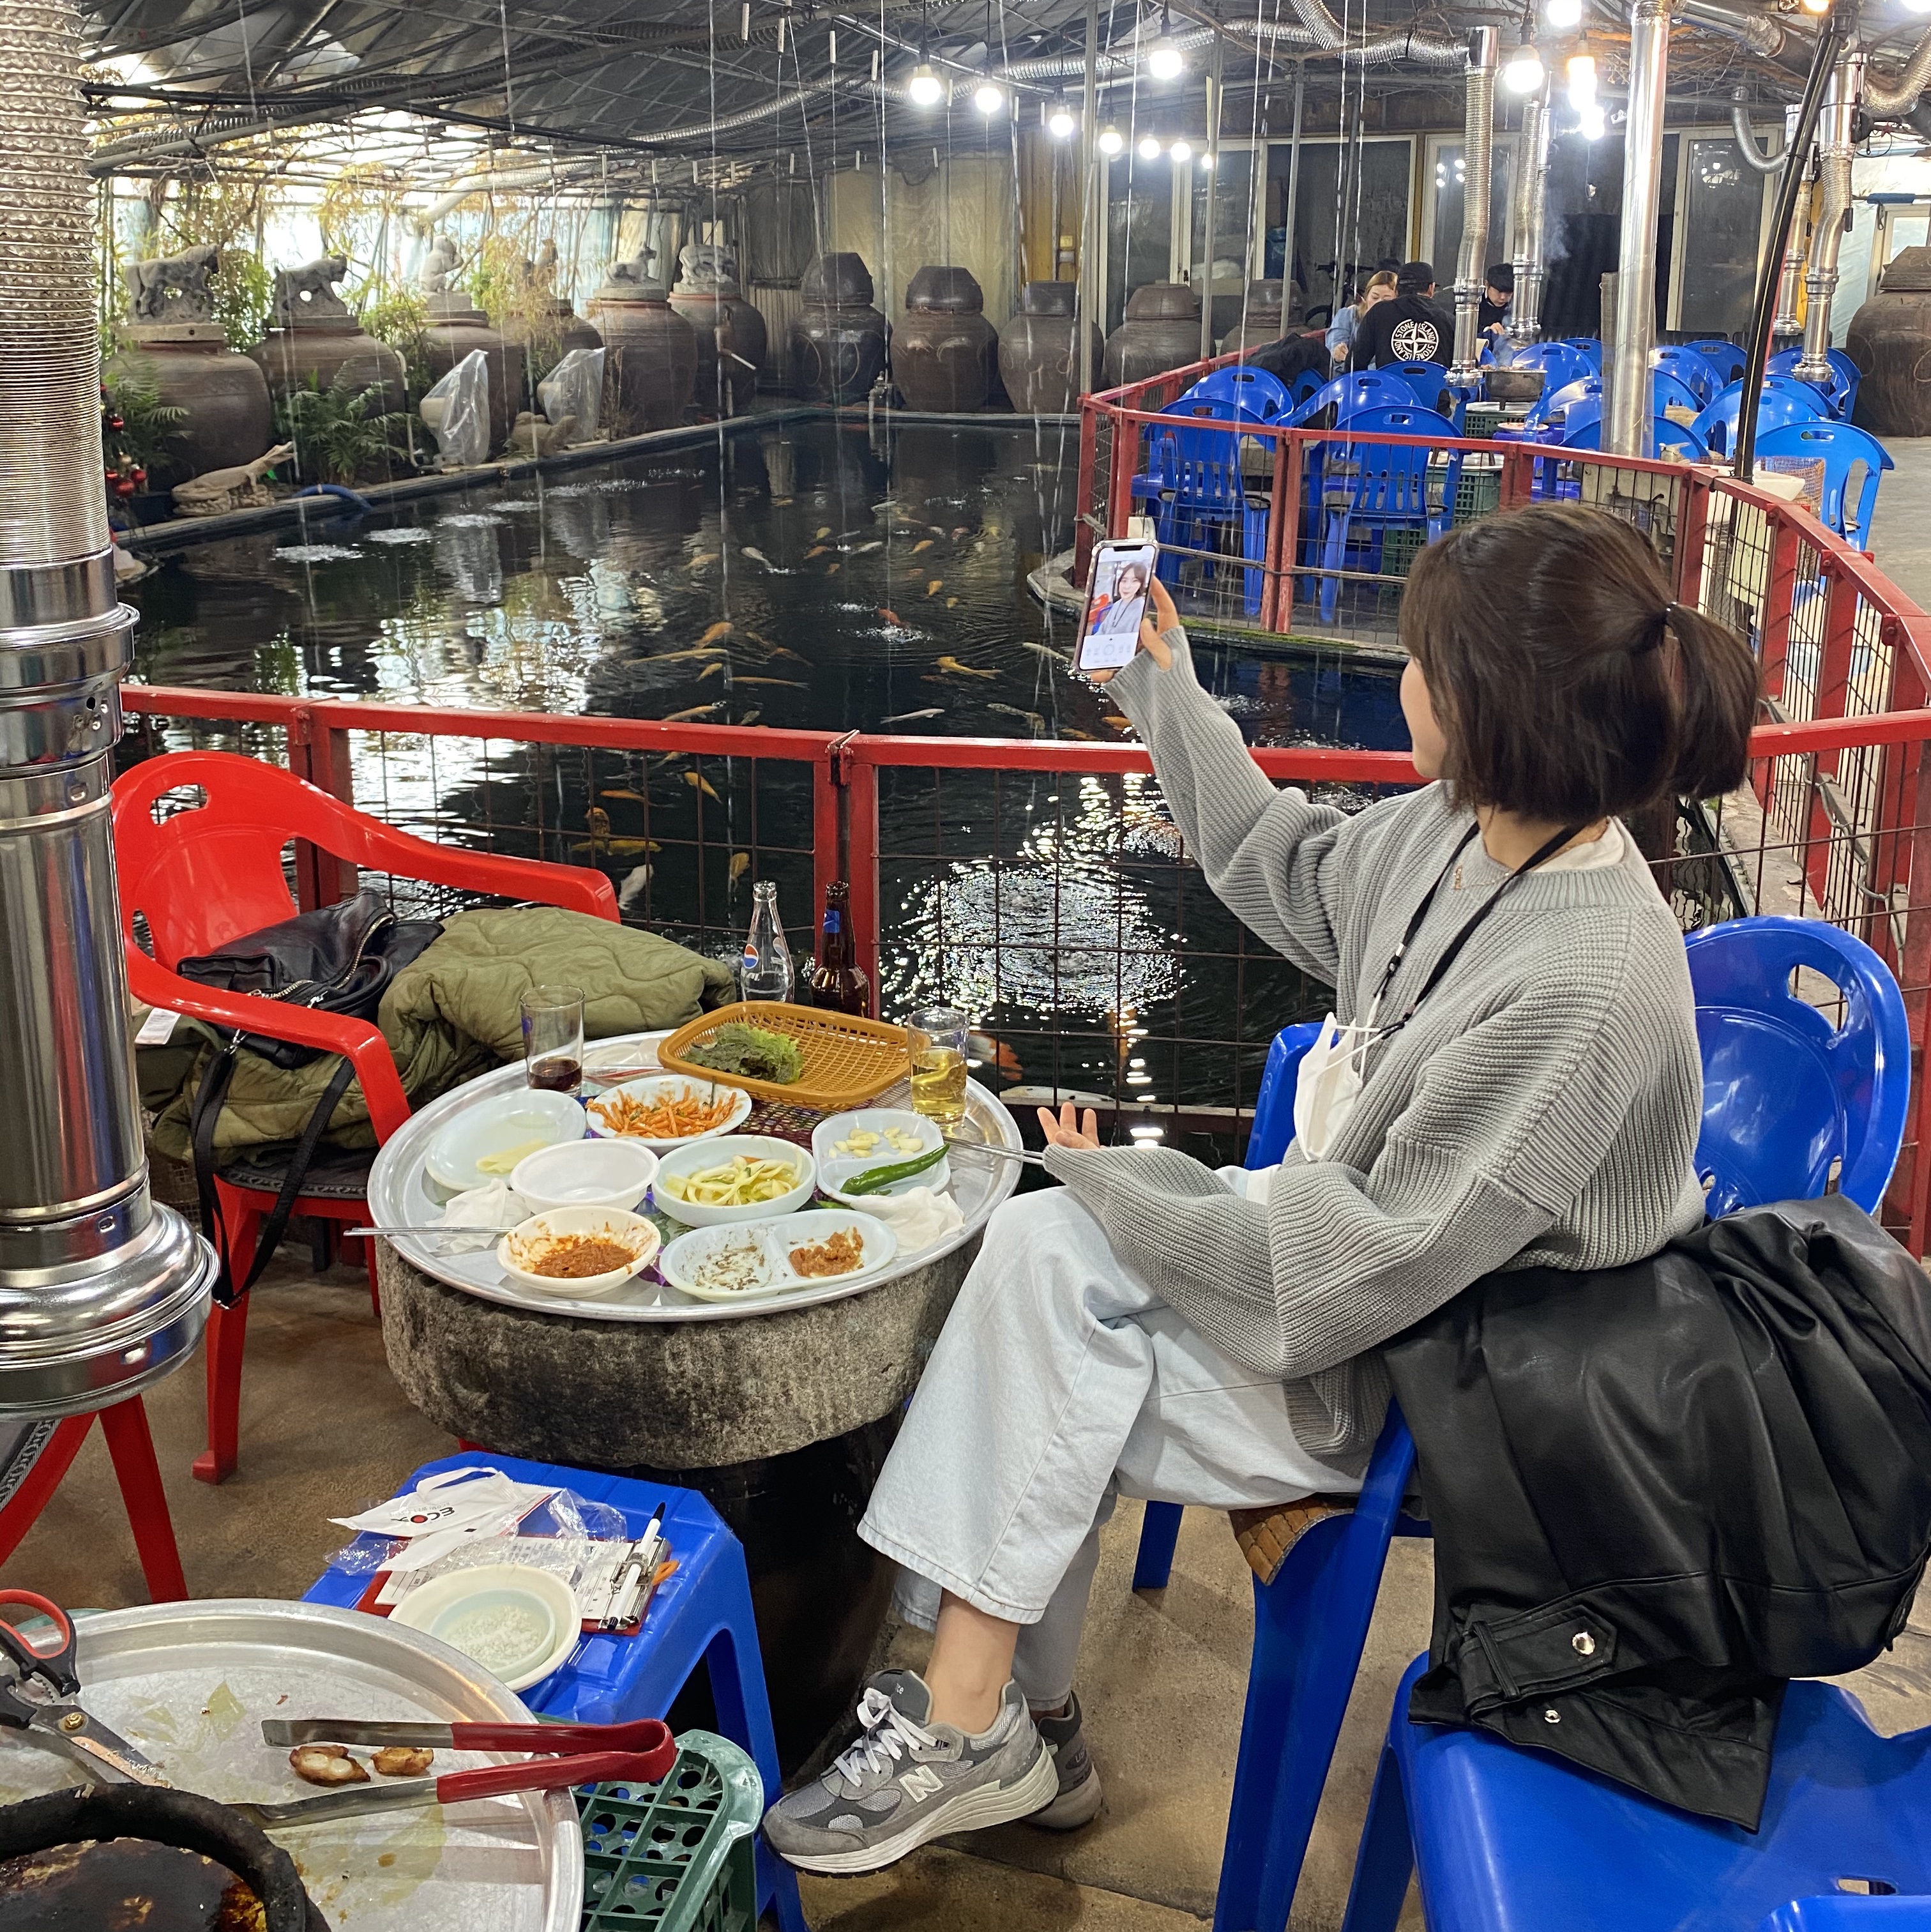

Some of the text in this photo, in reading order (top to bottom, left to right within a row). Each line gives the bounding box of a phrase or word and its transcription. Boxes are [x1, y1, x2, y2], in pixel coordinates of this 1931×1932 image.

[1395, 321, 1435, 341] STONE ISLAND
[1394, 342, 1434, 360] STONE ISLAND
[898, 1764, 944, 1803] N
